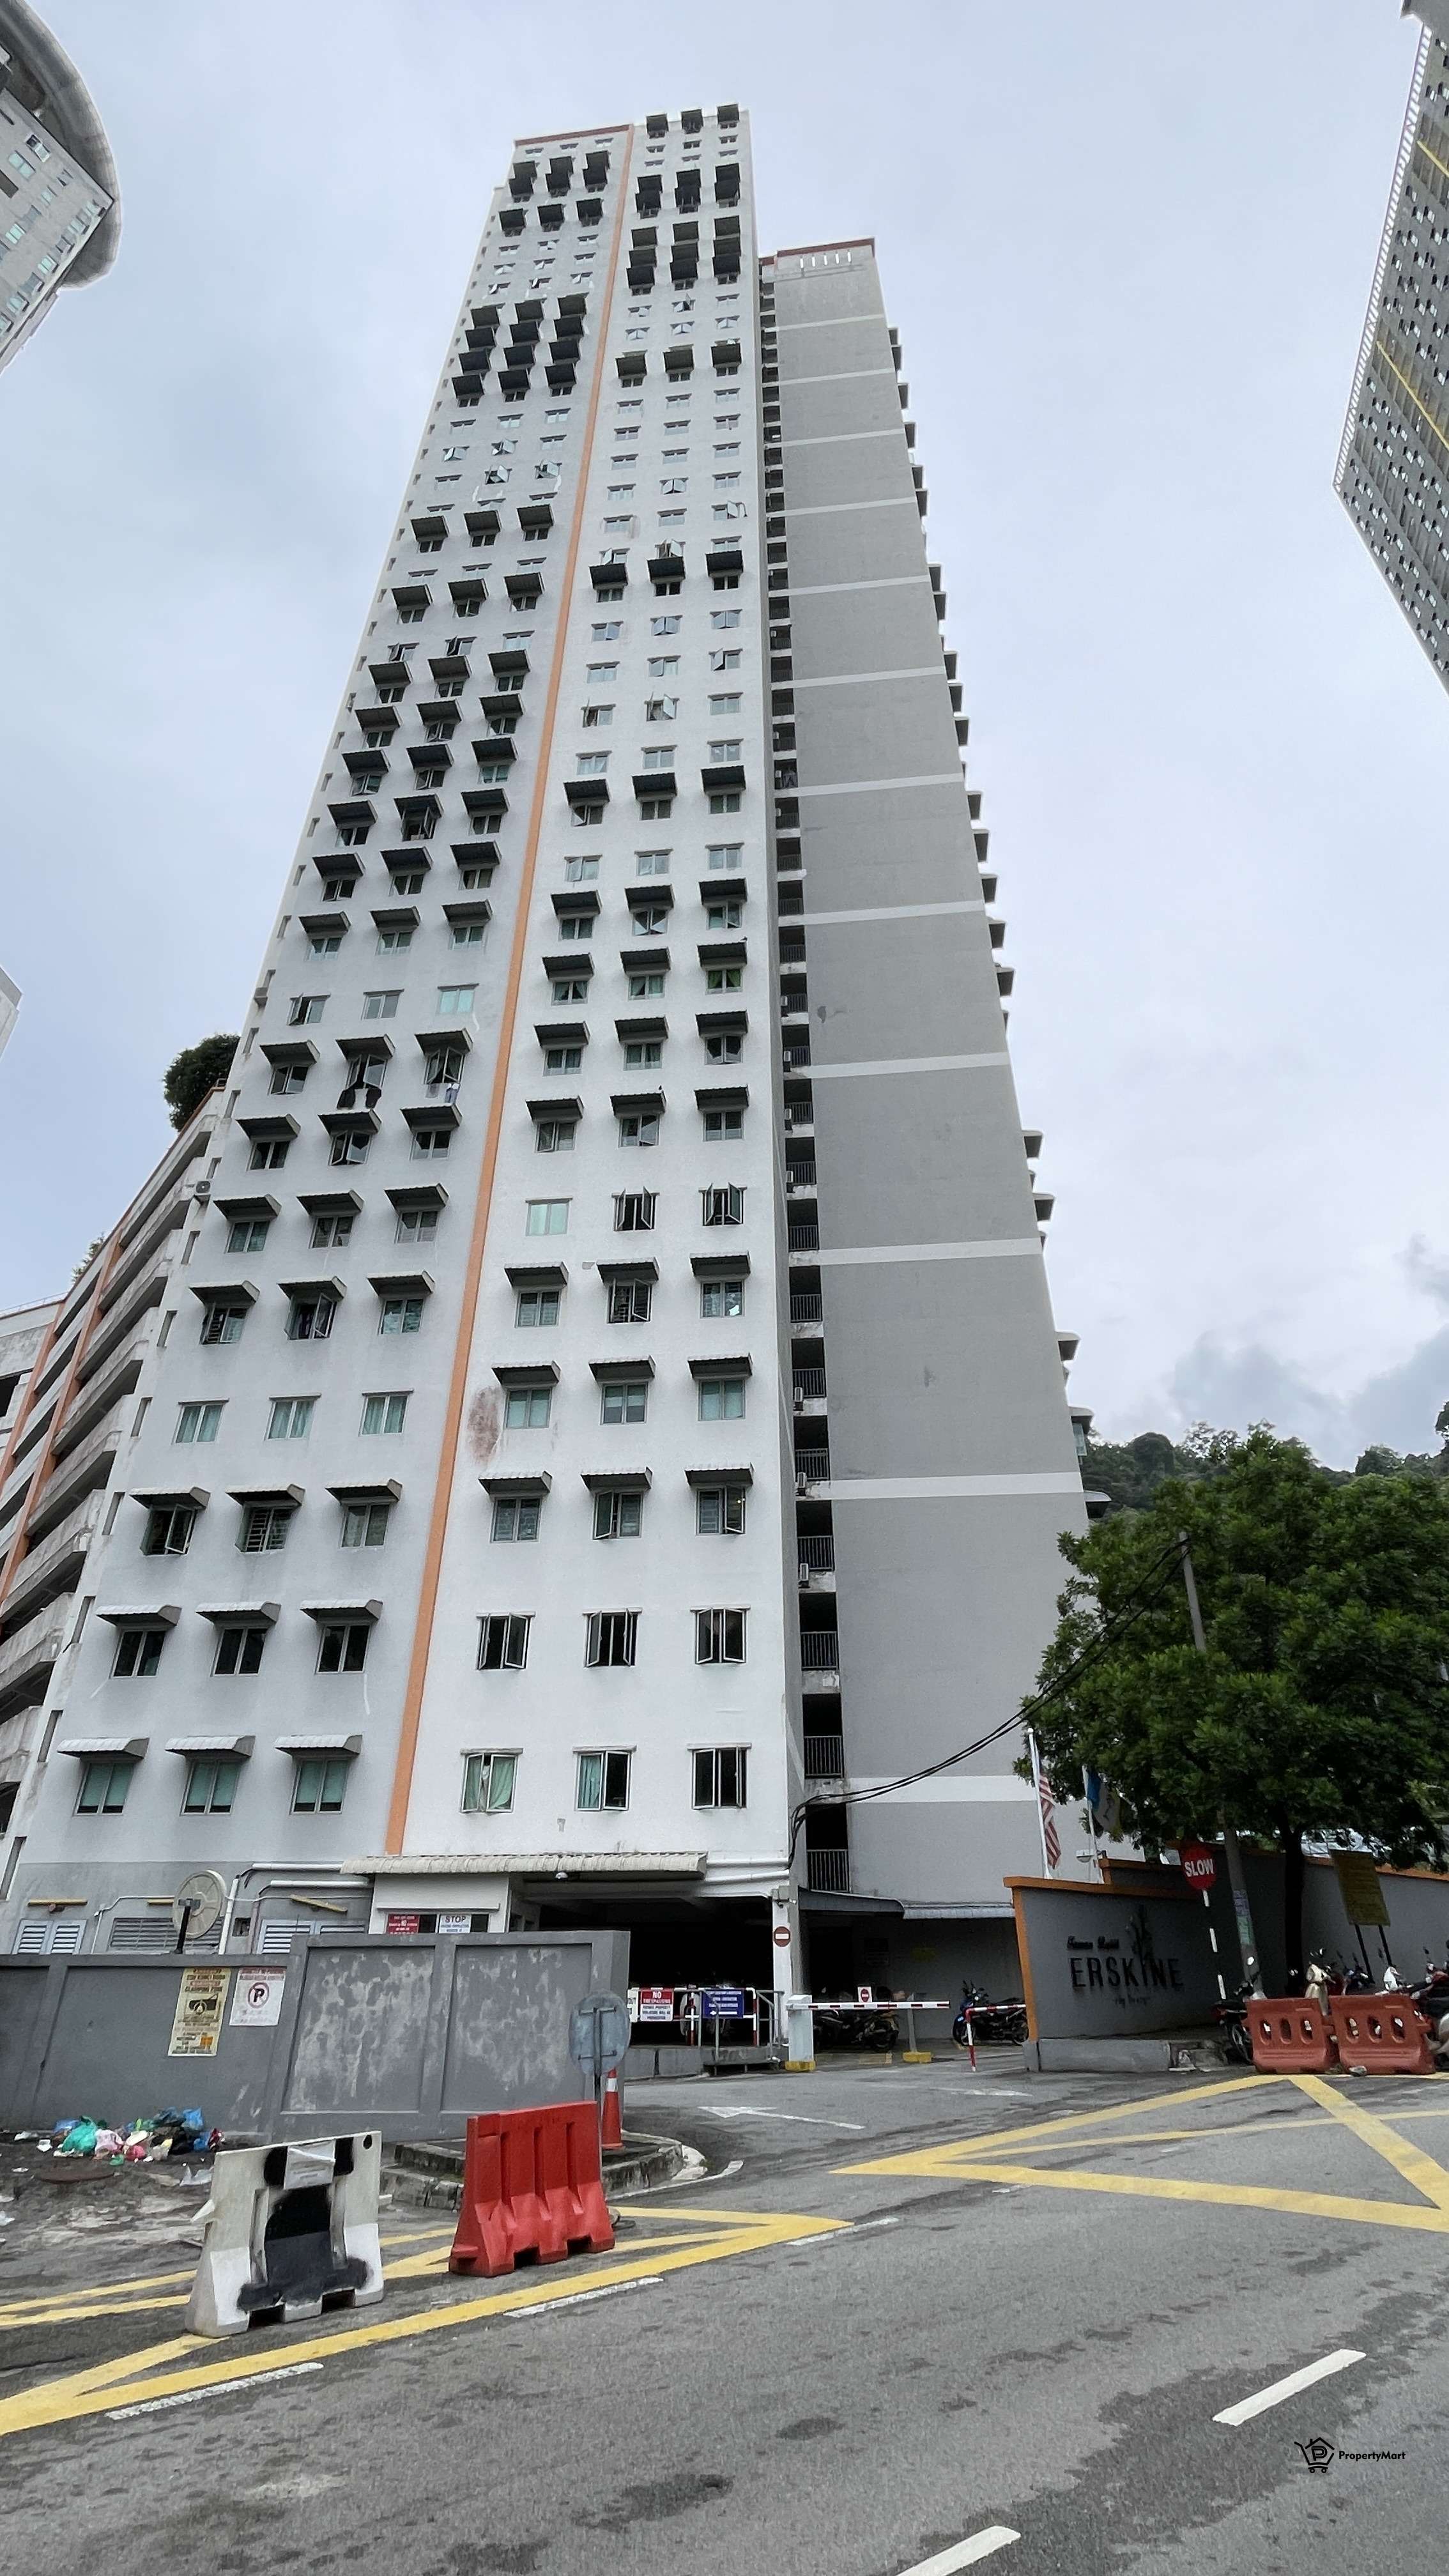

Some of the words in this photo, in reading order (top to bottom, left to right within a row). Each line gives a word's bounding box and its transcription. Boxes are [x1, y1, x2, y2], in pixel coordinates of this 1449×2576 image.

[1184, 1859, 1214, 1877] SLOW
[1070, 1956, 1184, 1988] ERSKINE
[254, 1988, 265, 2003] P
